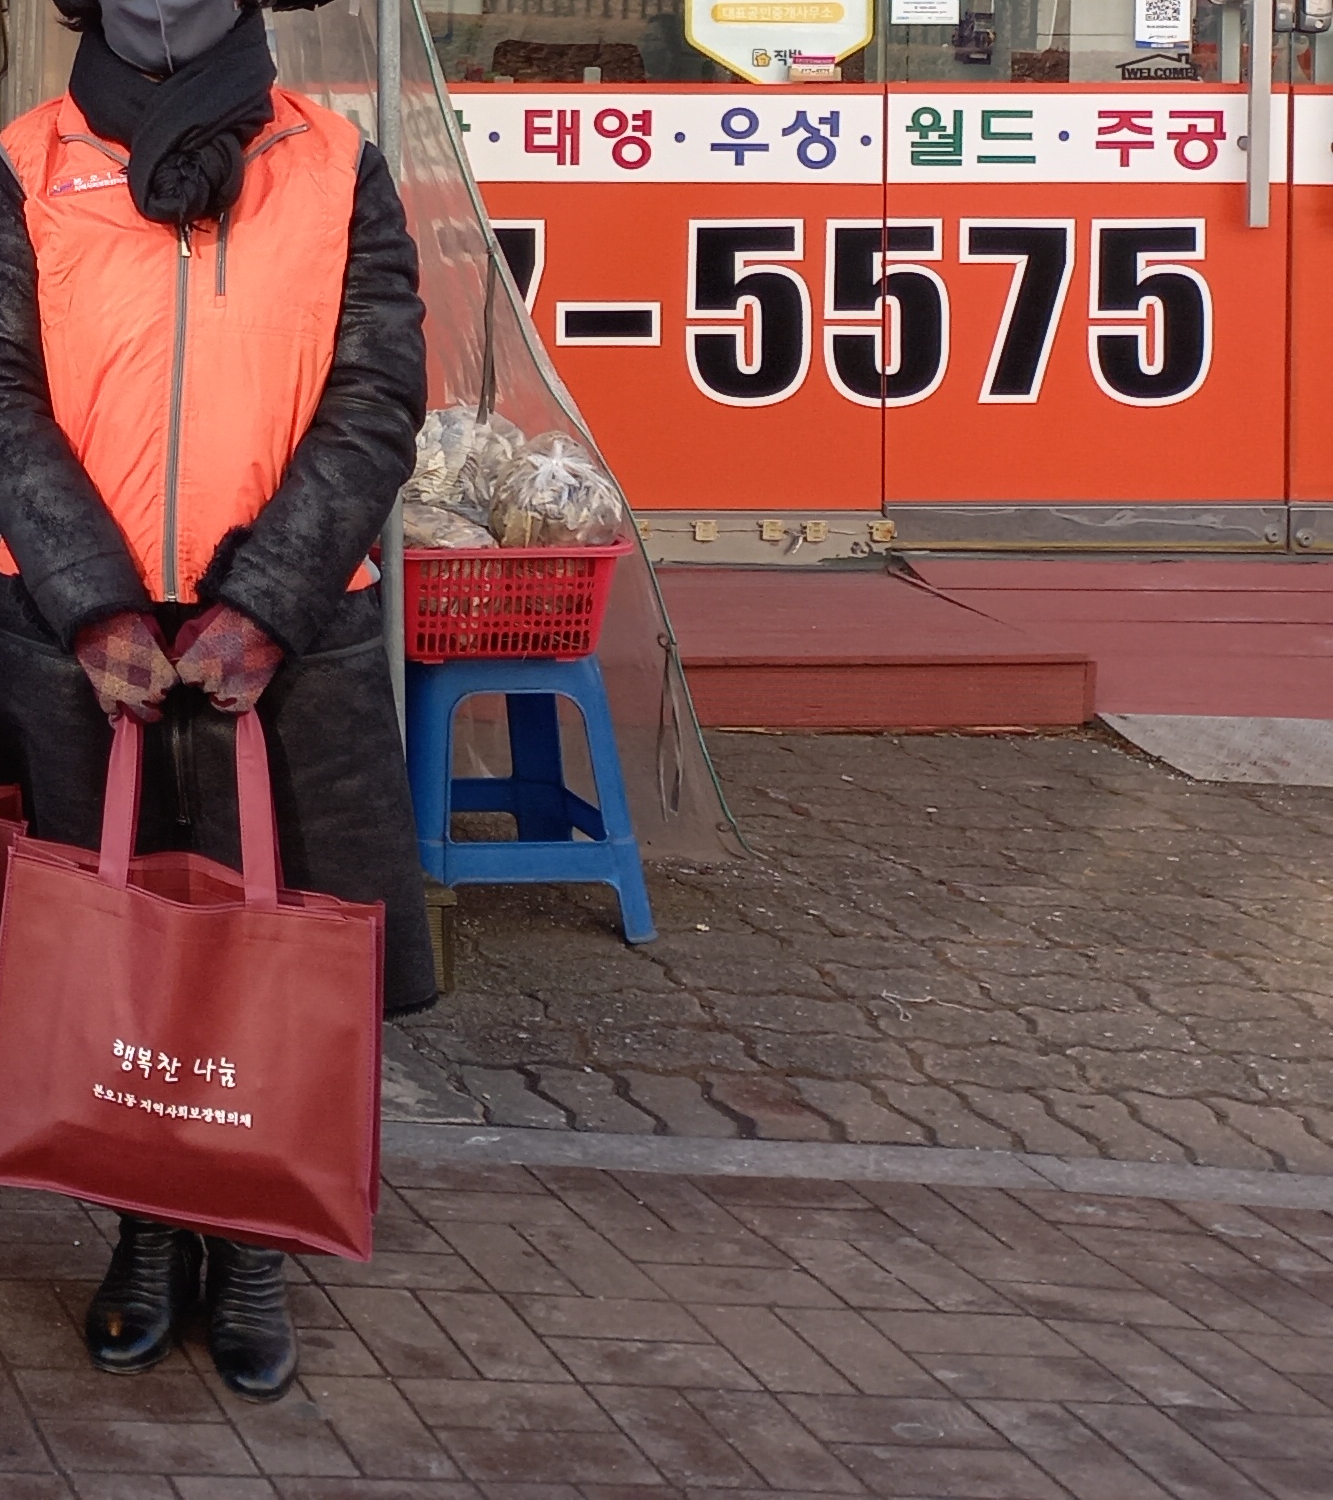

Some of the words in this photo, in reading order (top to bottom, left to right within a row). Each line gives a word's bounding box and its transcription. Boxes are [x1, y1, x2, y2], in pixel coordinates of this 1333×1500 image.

[1125, 67, 1198, 80] WELCOME
[524, 108, 653, 170] 태영
[710, 107, 840, 170] 우성
[905, 106, 1036, 166] 월드
[1095, 110, 1227, 170] 주공
[113, 1038, 182, 1082] 행복찬
[193, 1056, 237, 1088] 나눔
